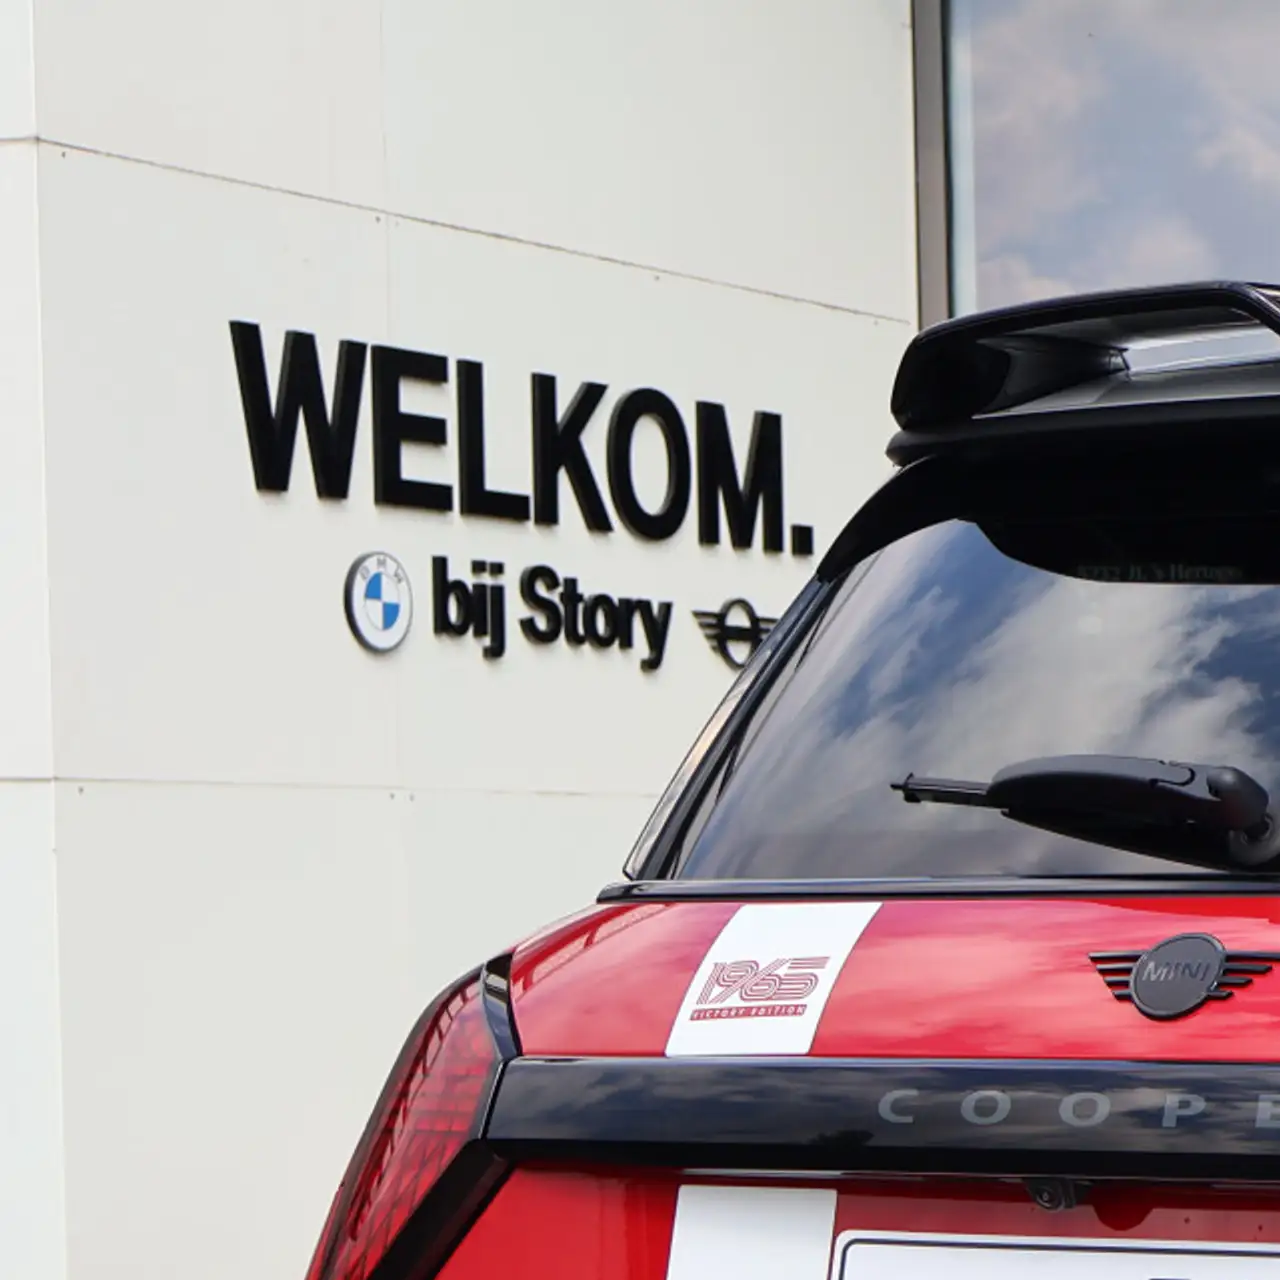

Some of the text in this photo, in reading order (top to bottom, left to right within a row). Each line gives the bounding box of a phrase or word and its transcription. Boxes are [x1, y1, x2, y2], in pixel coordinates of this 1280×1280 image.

[228, 319, 815, 557] WELKOM.
[431, 555, 673, 672] bij Story
[696, 956, 830, 1005] 1965
[1142, 960, 1211, 981] MINI
[750, 1005, 806, 1016] EDITION
